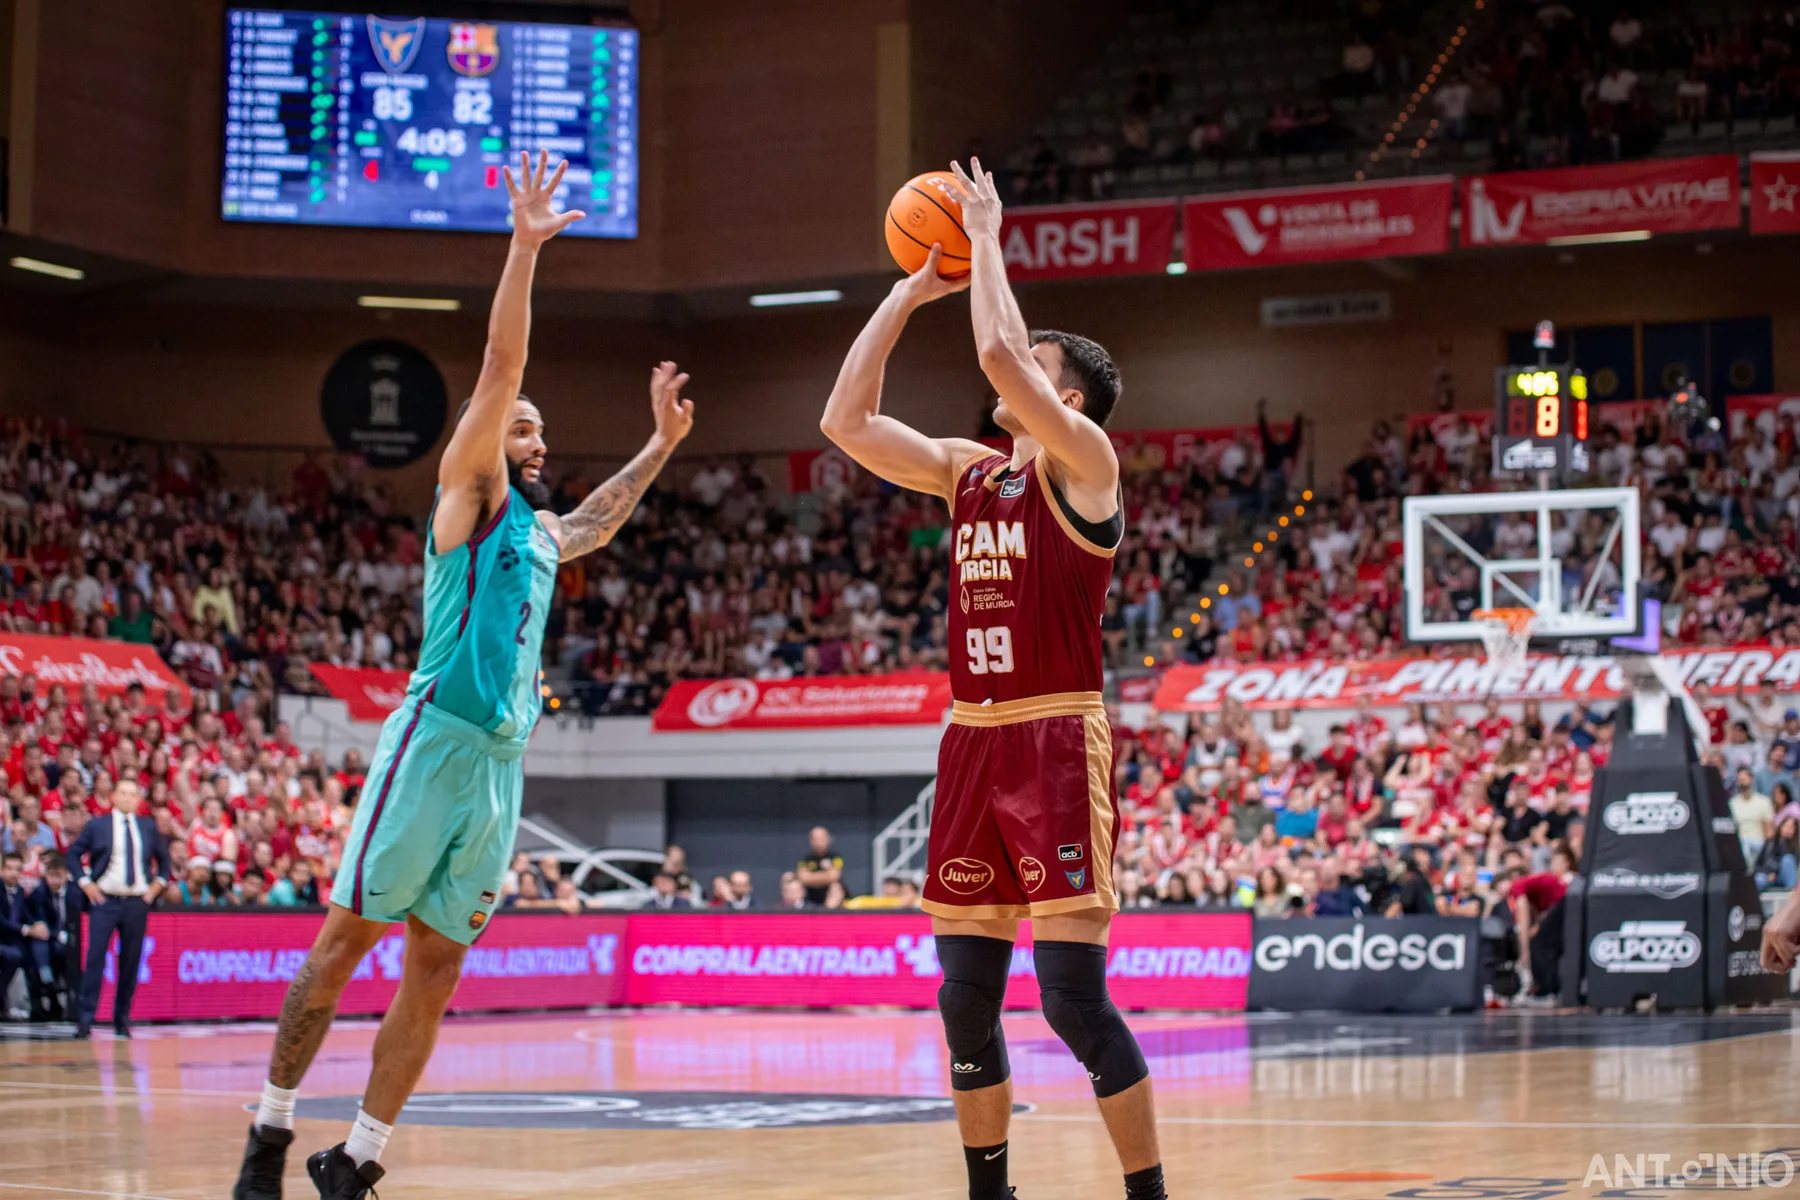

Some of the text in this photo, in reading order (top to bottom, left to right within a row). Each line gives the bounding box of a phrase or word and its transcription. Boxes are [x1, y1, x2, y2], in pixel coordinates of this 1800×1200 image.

[373, 87, 493, 124] 85 82
[397, 127, 467, 157] 4:05
[1637, 178, 1729, 208] VITAE
[1536, 396, 1560, 438] 8
[973, 592, 1004, 602] REGIÓN
[974, 600, 1016, 611] DE MURCIA
[514, 601, 532, 646] 2
[966, 626, 1015, 675] 99
[1186, 664, 1348, 702] ZONA
[1061, 849, 1077, 859] acb
[944, 868, 989, 883] Juver
[633, 945, 897, 976] COMPRALAENTRADA
[1255, 923, 1465, 972] endesa
